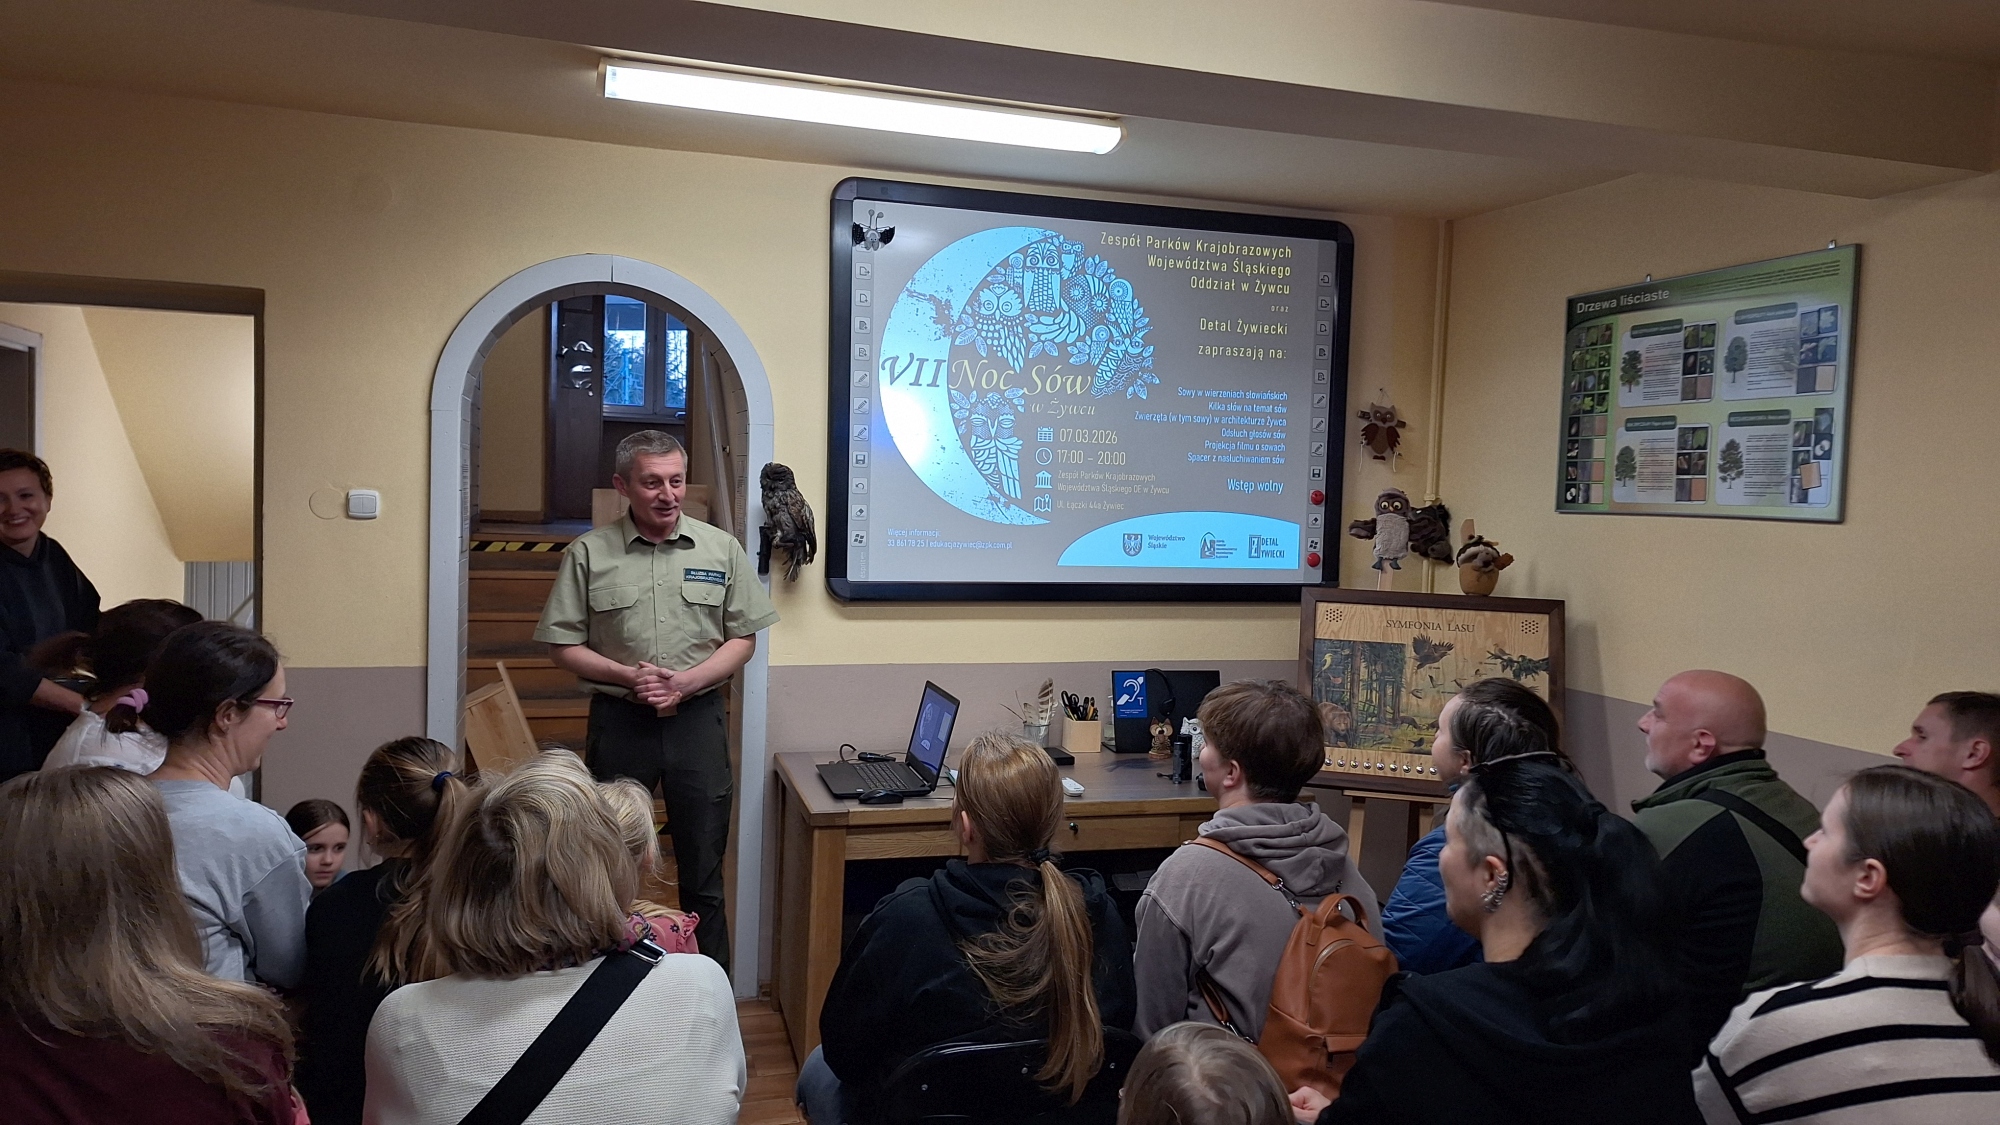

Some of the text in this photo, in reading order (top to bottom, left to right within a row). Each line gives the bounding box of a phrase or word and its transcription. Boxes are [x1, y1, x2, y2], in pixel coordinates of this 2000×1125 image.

[1101, 232, 1292, 260] Zespół Parków Krajobrazowych
[1148, 254, 1291, 278] Województwa Śląskiego
[1191, 276, 1290, 296] Oddział w Żywcu
[1576, 290, 1669, 314] Drzewa liściaste
[1200, 318, 1288, 336] Detal Żywiecki
[1198, 345, 1286, 360] zapraszają na:
[880, 352, 1092, 396] VII Noc Sów
[1178, 387, 1195, 398] Sowy
[1205, 388, 1244, 399] wierzeniach
[1246, 389, 1288, 400] słowiańskich
[1030, 398, 1095, 418] w Żywcu
[1209, 402, 1225, 411] Kilka
[1227, 402, 1242, 412] słów
[1254, 404, 1273, 413] temat
[1274, 404, 1287, 414] sów
[1135, 411, 1286, 428] Zwierzęta (w tym sowy) w architekturze Żywca
[1060, 428, 1118, 444] 07.03.2026
[1222, 428, 1286, 440] Odsłuch głosów sów
[1205, 440, 1235, 452] Projekcja
[1237, 442, 1254, 451] filmu
[1261, 442, 1285, 452] sowach
[1057, 450, 1083, 464] 17:00
[1098, 452, 1126, 465] 20:00
[1188, 452, 1210, 463] Spacer
[1218, 453, 1270, 464] nasłuchiwaniem
[1272, 454, 1285, 464] sów
[1058, 470, 1155, 483] Zespół Parków Krajobrazowych
[1058, 482, 1100, 493] Województwa
[1101, 482, 1132, 494] Śląskiego
[1134, 485, 1141, 493] OE
[1150, 485, 1169, 495] Żywcu
[1228, 479, 1284, 494] Wstęp wolny
[1066, 500, 1088, 510] Łączki
[1089, 501, 1101, 509] 44a
[1103, 501, 1124, 511] Żywiec
[888, 528, 940, 538] Więcej informacji:
[1148, 534, 1185, 542] Województwo
[1262, 538, 1278, 546] DETAL
[1386, 620, 1475, 632] SYMFONIA LASU
[1137, 697, 1144, 705] T
